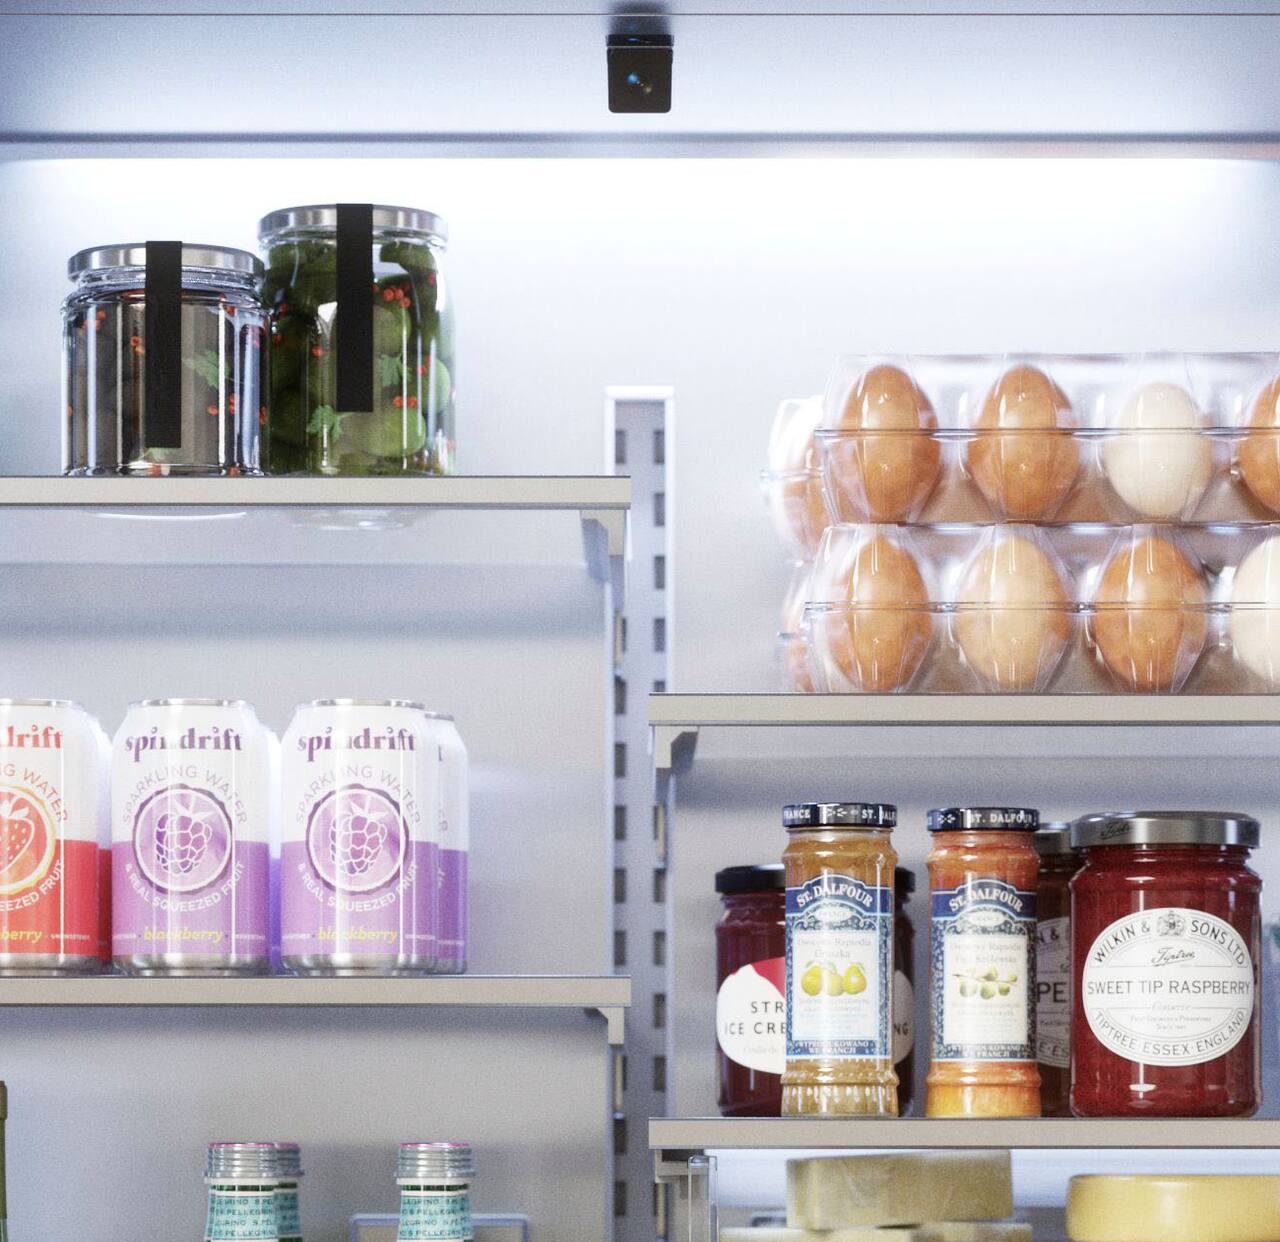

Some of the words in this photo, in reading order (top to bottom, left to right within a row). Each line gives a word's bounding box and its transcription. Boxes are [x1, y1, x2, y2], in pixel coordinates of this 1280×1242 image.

[296, 765, 373, 824] SPARKNG
[861, 809, 878, 820] ST.
[813, 882, 874, 907] DALFOUR
[143, 926, 223, 944] blakberry
[1094, 923, 1136, 964] WILKIN
[1141, 920, 1151, 934] &
[1191, 919, 1228, 946] SONS
[1226, 938, 1245, 966] LTD
[1087, 980, 1133, 996] SWEET
[1138, 980, 1163, 995] TIP
[1169, 980, 1252, 996] RASPBERRY
[1095, 1012, 1141, 1050] TIPTREE
